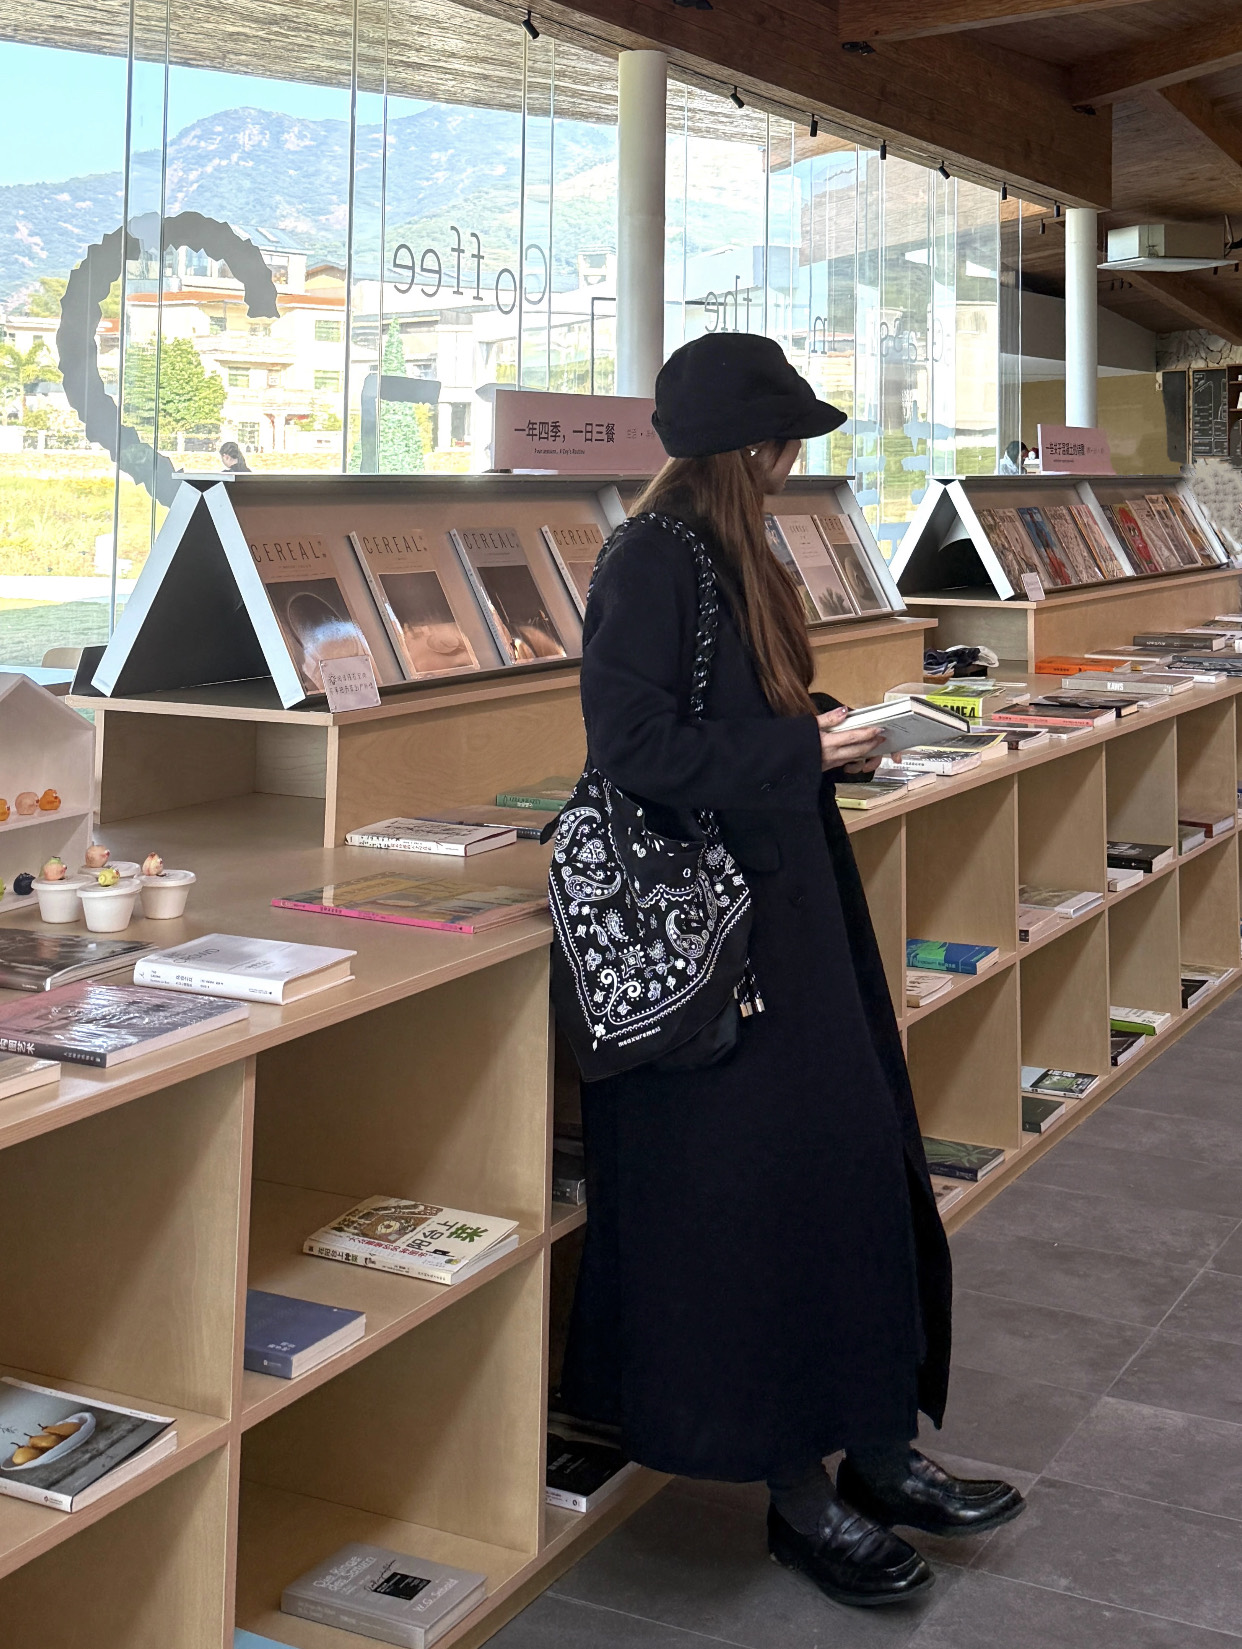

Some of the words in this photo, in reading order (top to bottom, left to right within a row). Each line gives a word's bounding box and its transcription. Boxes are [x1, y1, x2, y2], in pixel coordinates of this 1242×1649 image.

[514, 420, 616, 443] 一年四季，一日三餐
[363, 536, 423, 554] CEREAL
[463, 532, 515, 550] CEREAL
[552, 529, 598, 546] CEREAL
[250, 540, 321, 563] CEREAL
